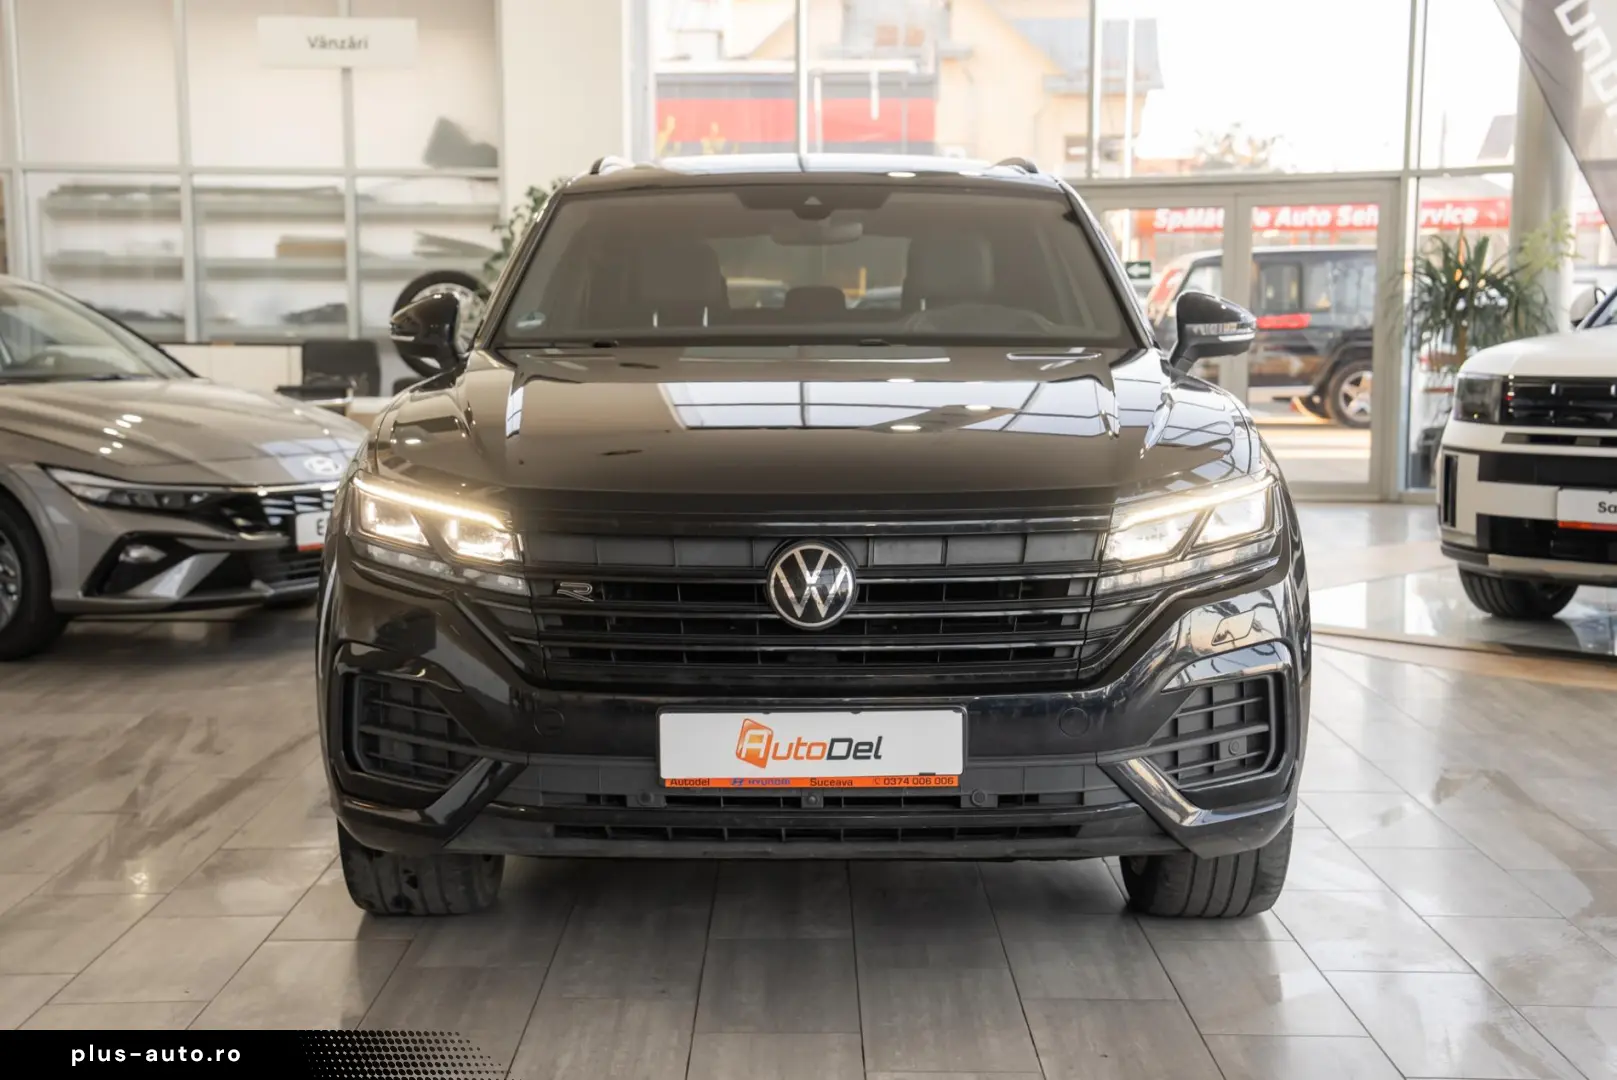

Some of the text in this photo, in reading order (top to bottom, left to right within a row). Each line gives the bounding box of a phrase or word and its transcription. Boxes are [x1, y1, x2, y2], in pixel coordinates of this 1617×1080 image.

[1275, 206, 1332, 226] Auto
[1421, 203, 1478, 225] rvice
[738, 722, 883, 764] AutoDel
[669, 778, 710, 787] Autodel
[809, 778, 853, 787] Suceava
[883, 776, 909, 786] 0374
